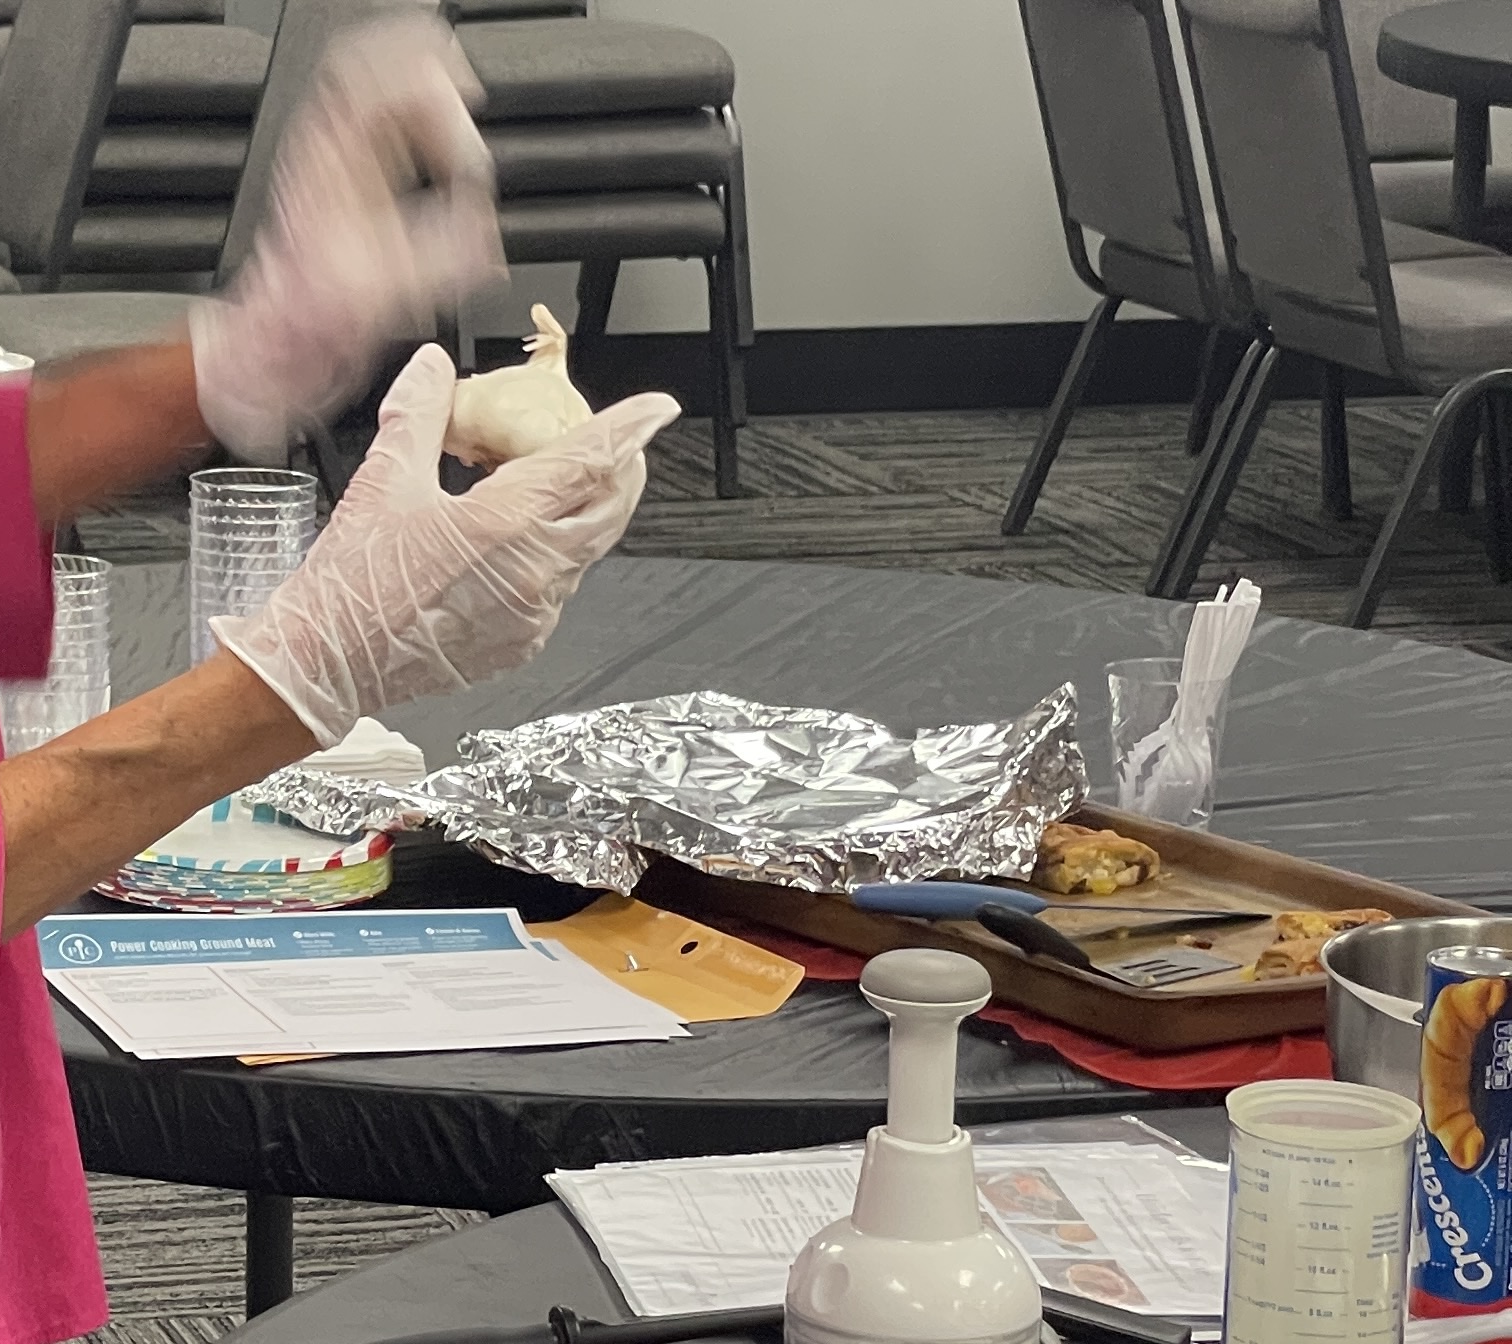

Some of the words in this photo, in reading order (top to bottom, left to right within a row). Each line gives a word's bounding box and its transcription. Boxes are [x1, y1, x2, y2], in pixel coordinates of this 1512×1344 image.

[110, 940, 146, 953] Power
[149, 939, 198, 952] Cooking
[200, 938, 244, 951] Ground
[245, 937, 277, 949] Meat
